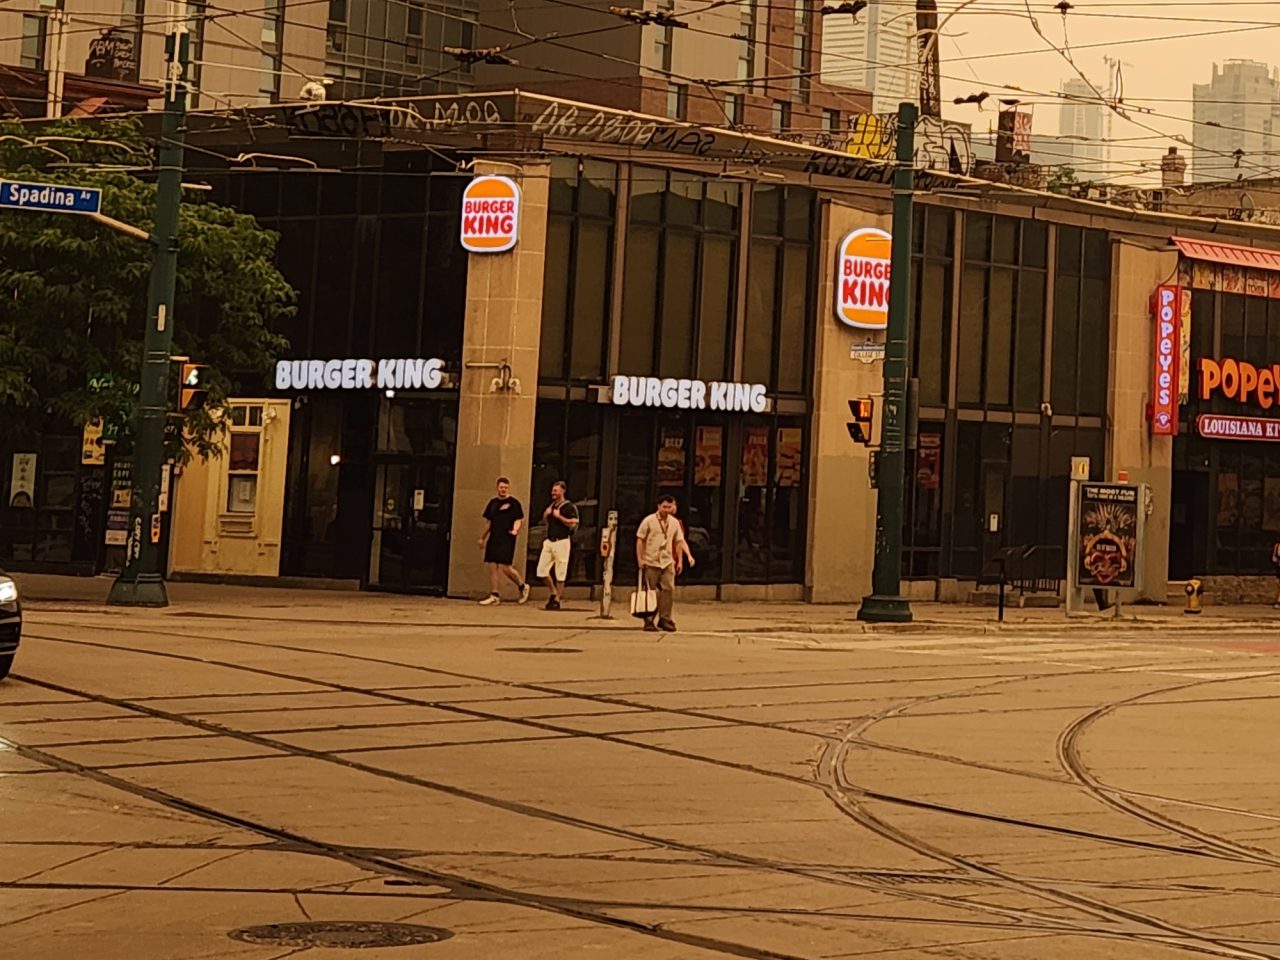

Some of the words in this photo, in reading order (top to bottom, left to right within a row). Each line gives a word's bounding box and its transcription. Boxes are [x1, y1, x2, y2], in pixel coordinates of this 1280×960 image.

[9, 184, 75, 206] Spadina
[80, 191, 91, 200] Av
[464, 200, 515, 214] BURGER
[463, 214, 514, 235] KING
[843, 258, 891, 281] BURGE
[275, 358, 374, 390] BURGER
[377, 358, 444, 390] KING
[612, 375, 706, 409] BURGER
[709, 381, 767, 413] KING
[1203, 418, 1264, 437] LOUISIANA
